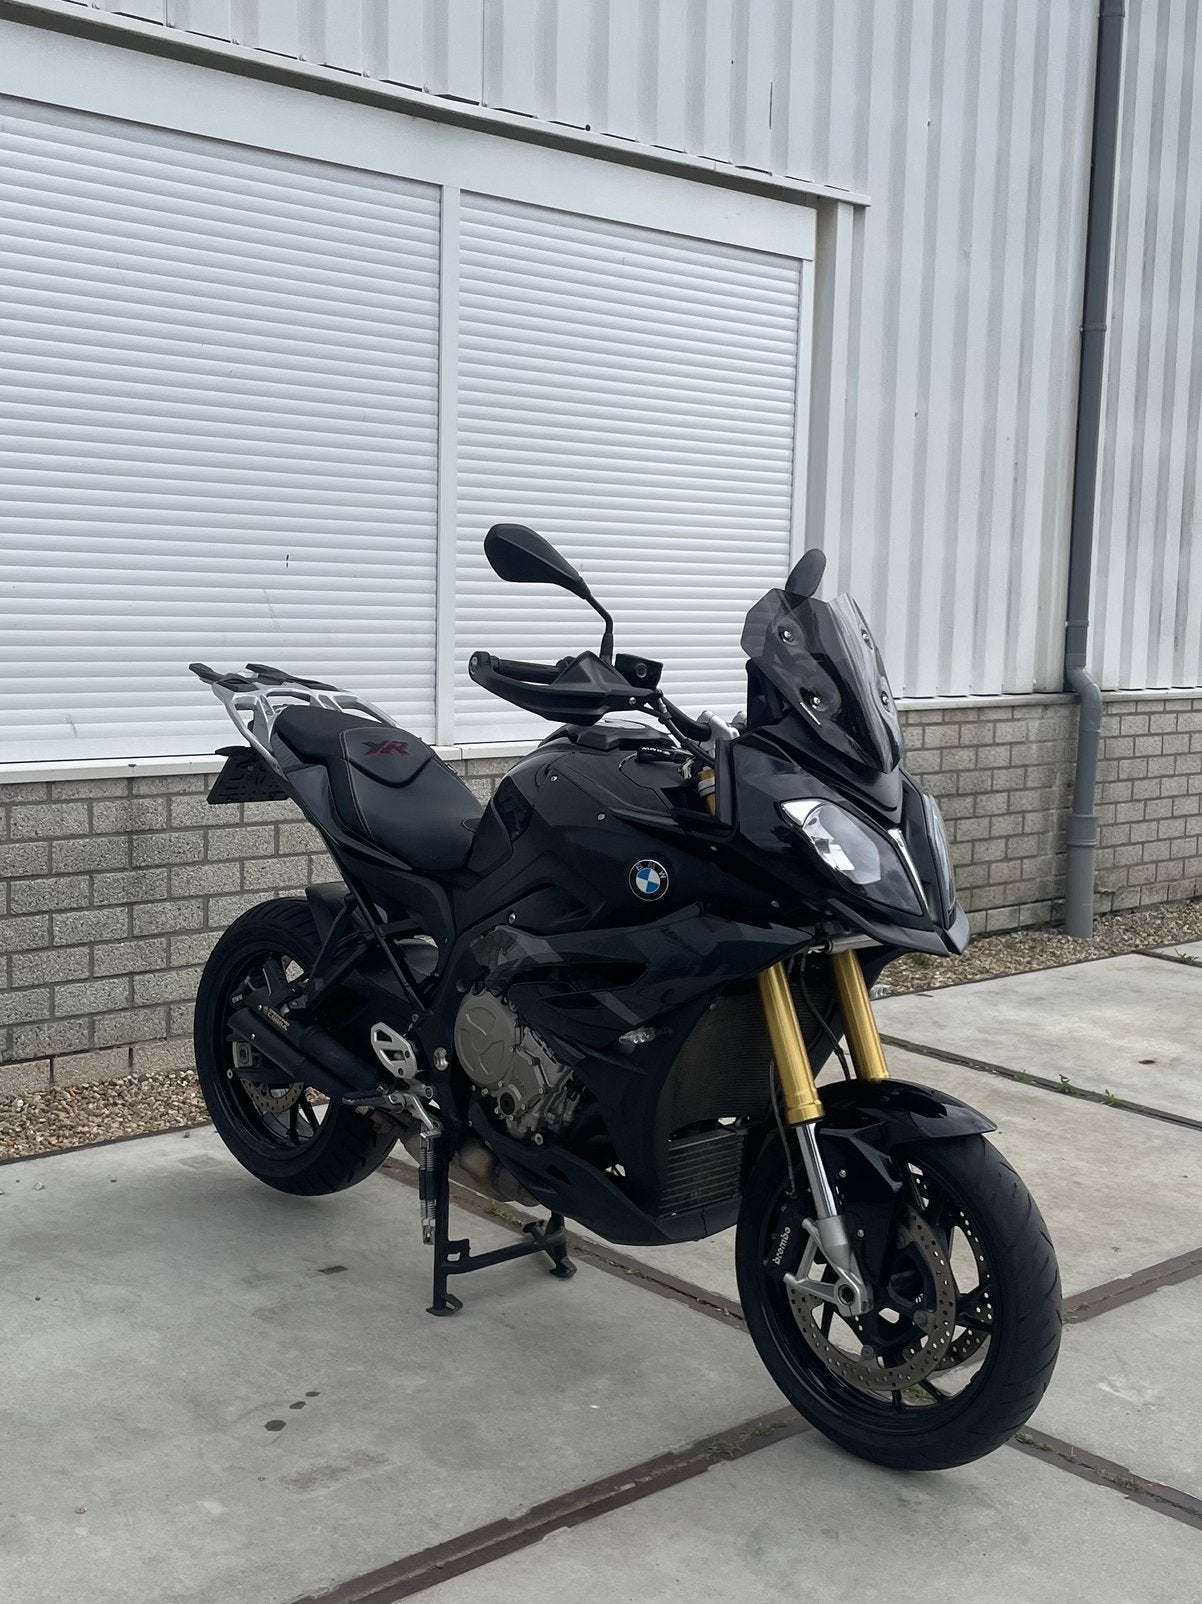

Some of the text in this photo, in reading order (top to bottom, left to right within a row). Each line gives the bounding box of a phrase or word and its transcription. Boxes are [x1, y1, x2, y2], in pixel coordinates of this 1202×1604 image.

[360, 740, 411, 757] XR
[635, 862, 667, 879] BMW
[771, 1226, 791, 1265] brembo
